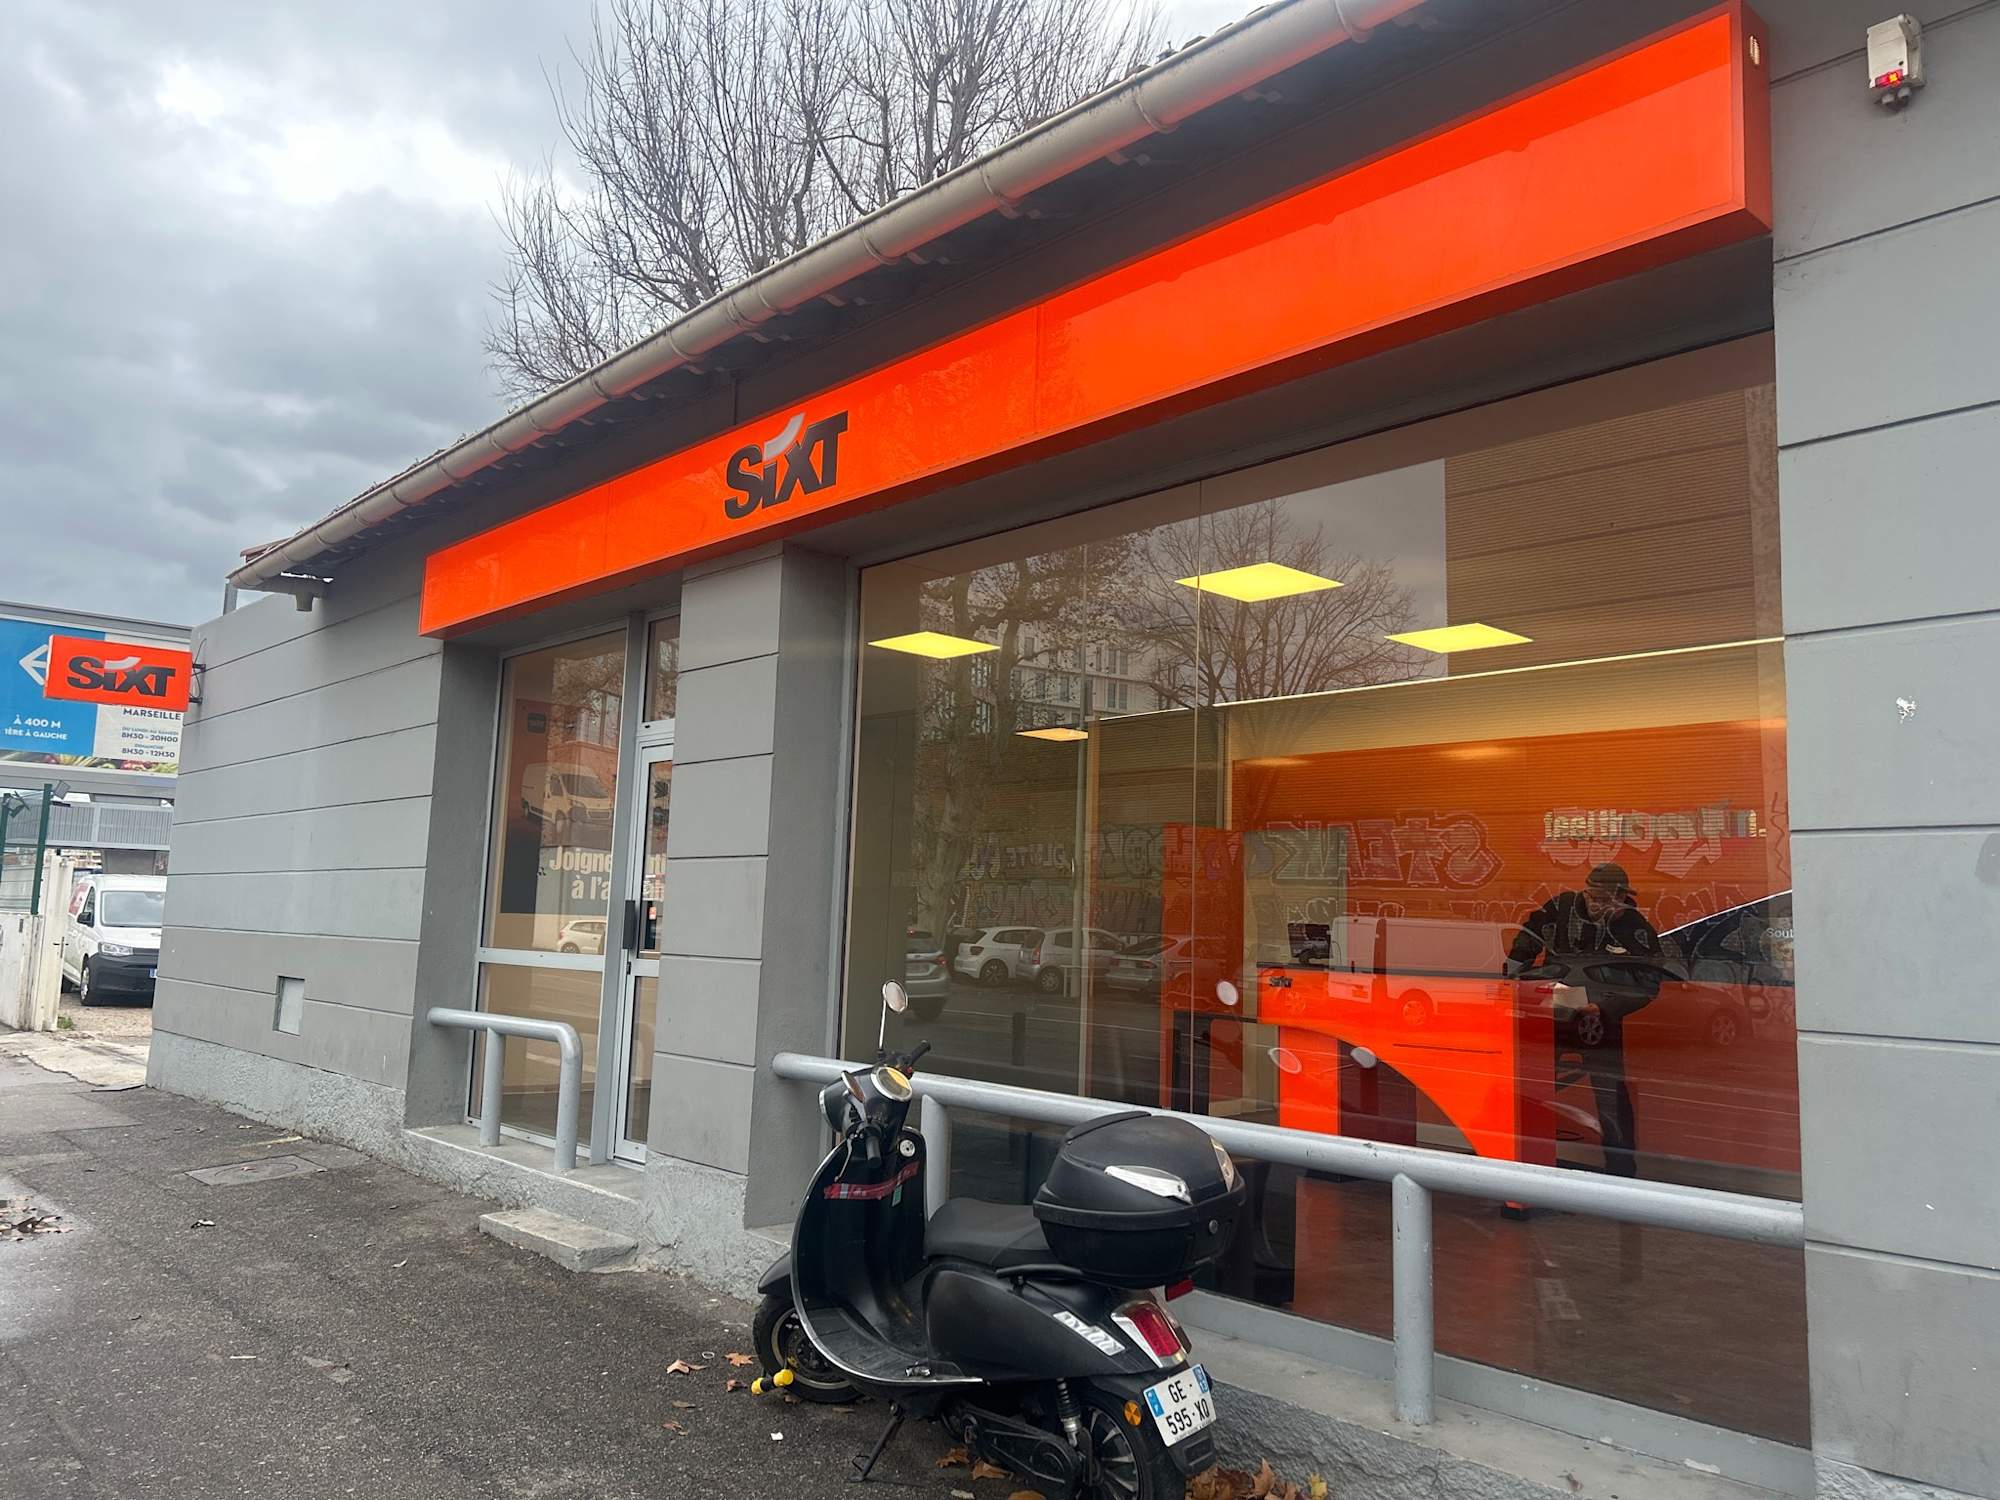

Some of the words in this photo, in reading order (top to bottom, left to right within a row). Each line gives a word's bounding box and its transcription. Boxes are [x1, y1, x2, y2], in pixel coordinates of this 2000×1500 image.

[123, 708, 181, 721] MARSEILLE
[13, 713, 22, 725] À
[24, 717, 49, 728] 400
[51, 720, 61, 729] M
[33, 730, 69, 741] GAUCHE
[121, 732, 144, 740] 8H30
[150, 734, 178, 743] 20H00
[121, 747, 144, 756] 8H30
[150, 750, 175, 758] 12H30
[571, 875, 585, 899] à
